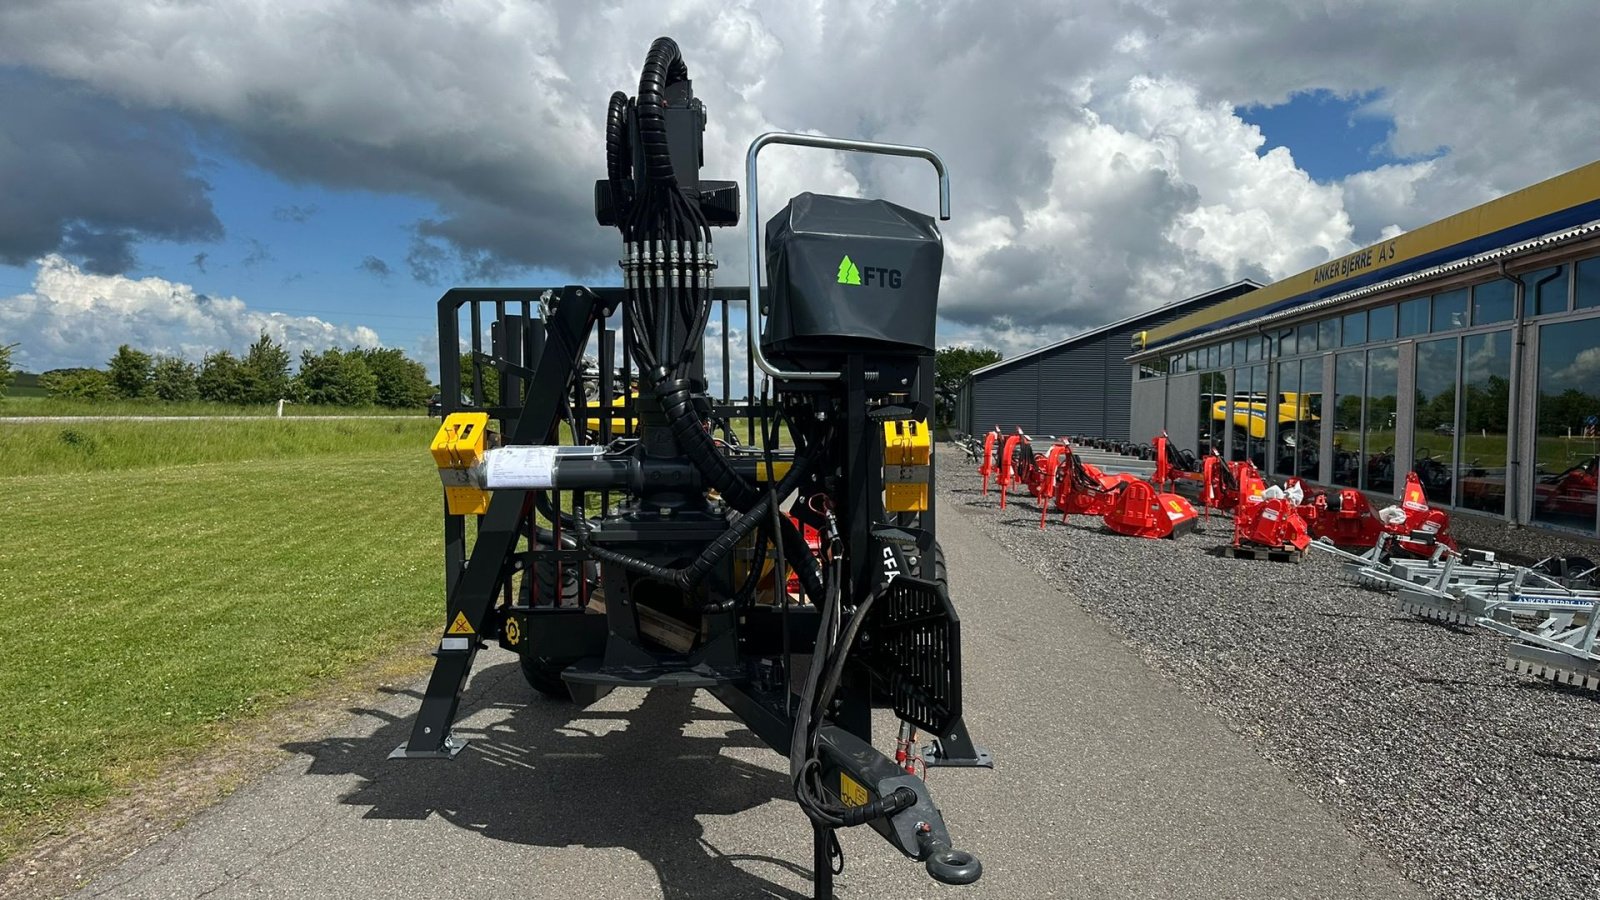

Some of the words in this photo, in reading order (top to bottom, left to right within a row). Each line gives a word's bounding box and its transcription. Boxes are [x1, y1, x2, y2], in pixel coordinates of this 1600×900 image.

[864, 266, 902, 289] FTG
[1314, 262, 1340, 284] ANKER
[1341, 250, 1372, 277] BJERRE
